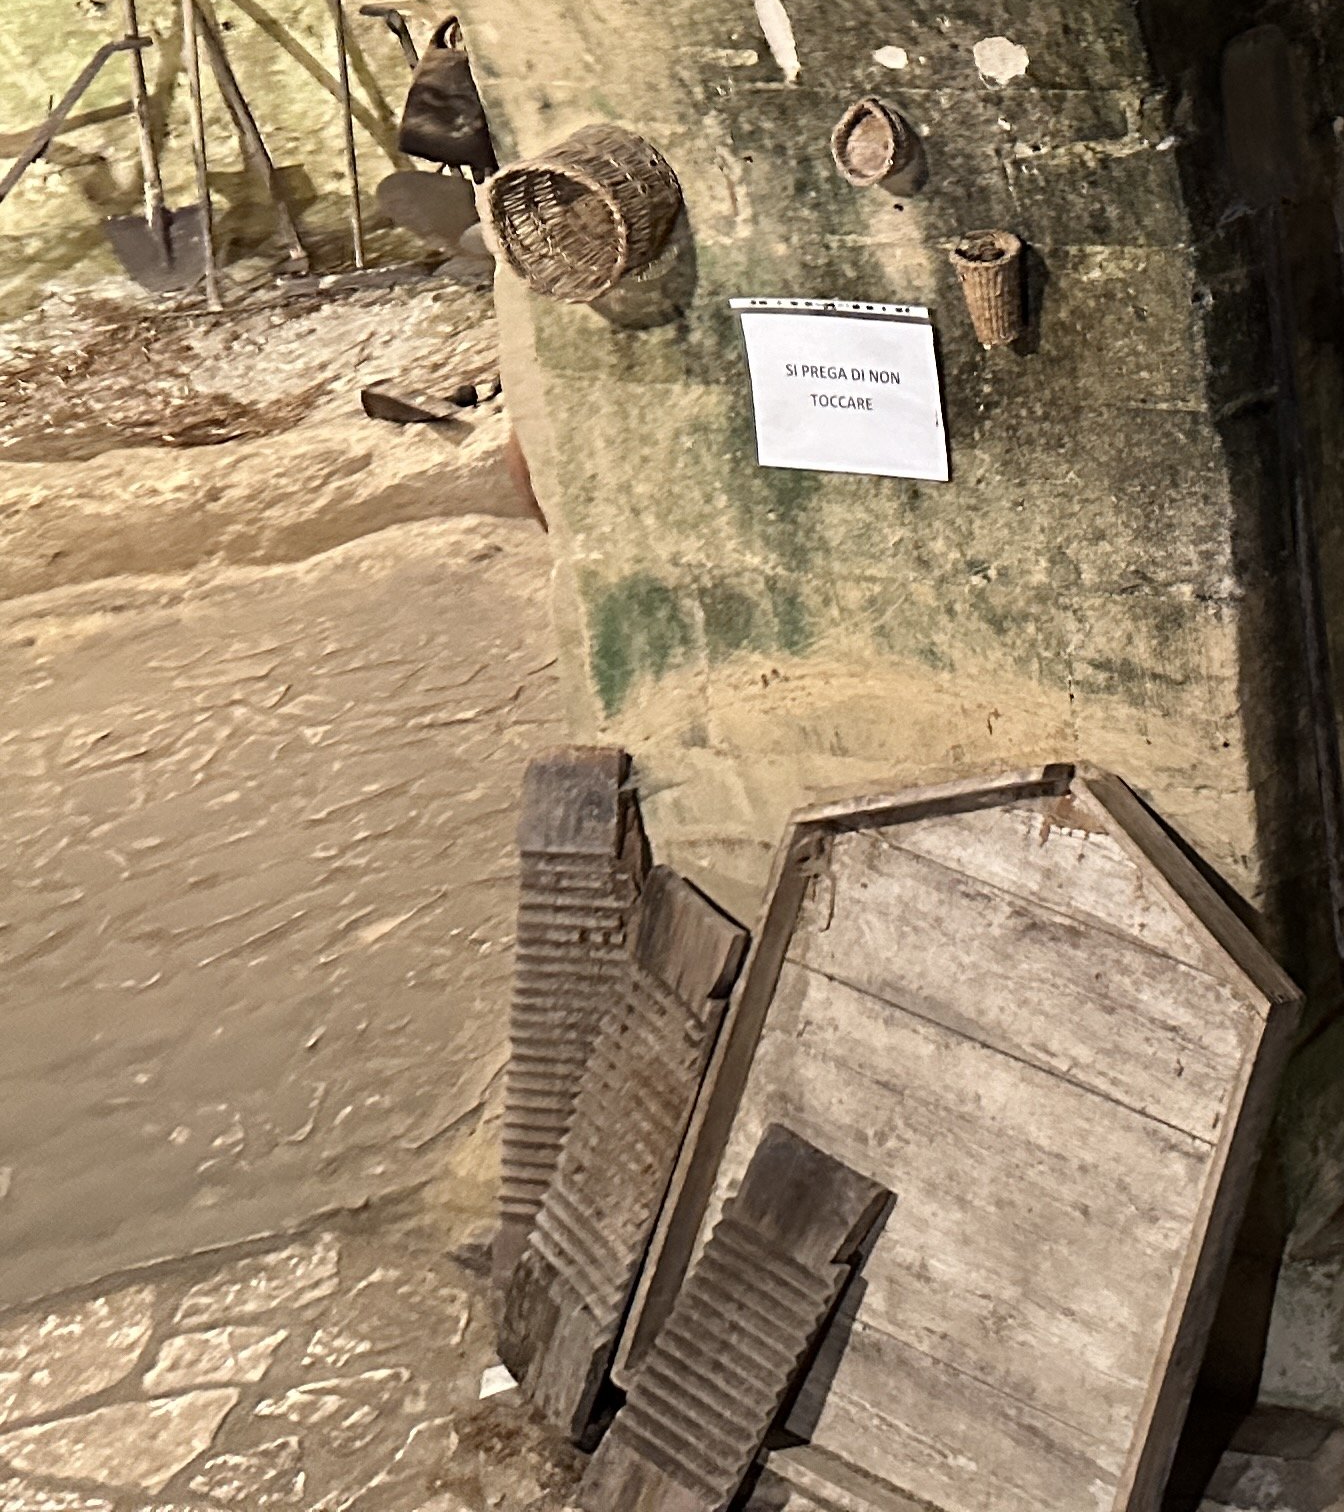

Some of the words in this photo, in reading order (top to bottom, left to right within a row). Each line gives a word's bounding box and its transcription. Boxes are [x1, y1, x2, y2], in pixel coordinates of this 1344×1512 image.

[786, 363, 798, 377] SI
[802, 364, 848, 381] PREGA
[851, 368, 865, 382] DI
[869, 369, 901, 385] NON
[810, 393, 873, 411] TOCCARE
